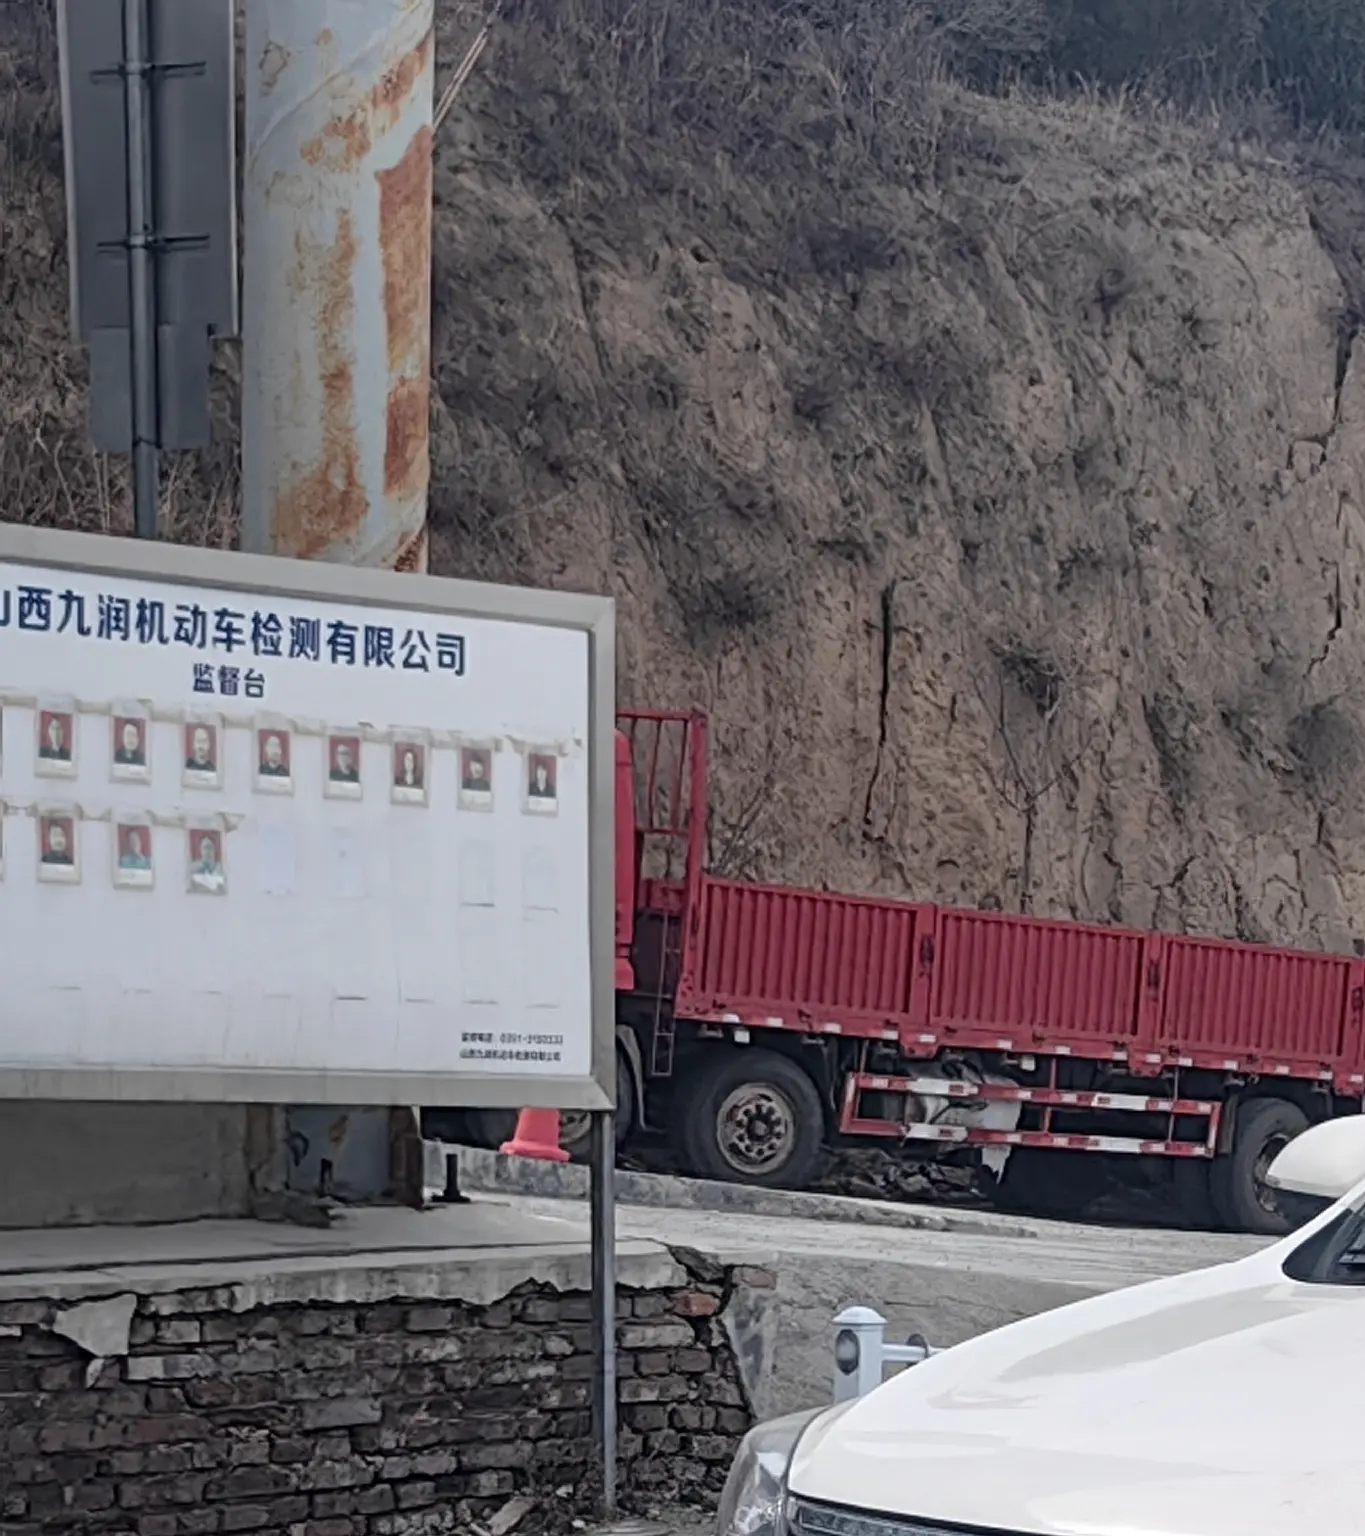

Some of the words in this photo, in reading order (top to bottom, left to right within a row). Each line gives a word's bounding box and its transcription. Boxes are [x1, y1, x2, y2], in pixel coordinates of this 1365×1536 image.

[0, 585, 468, 677] 西九润机动车检测有限公司
[193, 663, 266, 698] 监督台
